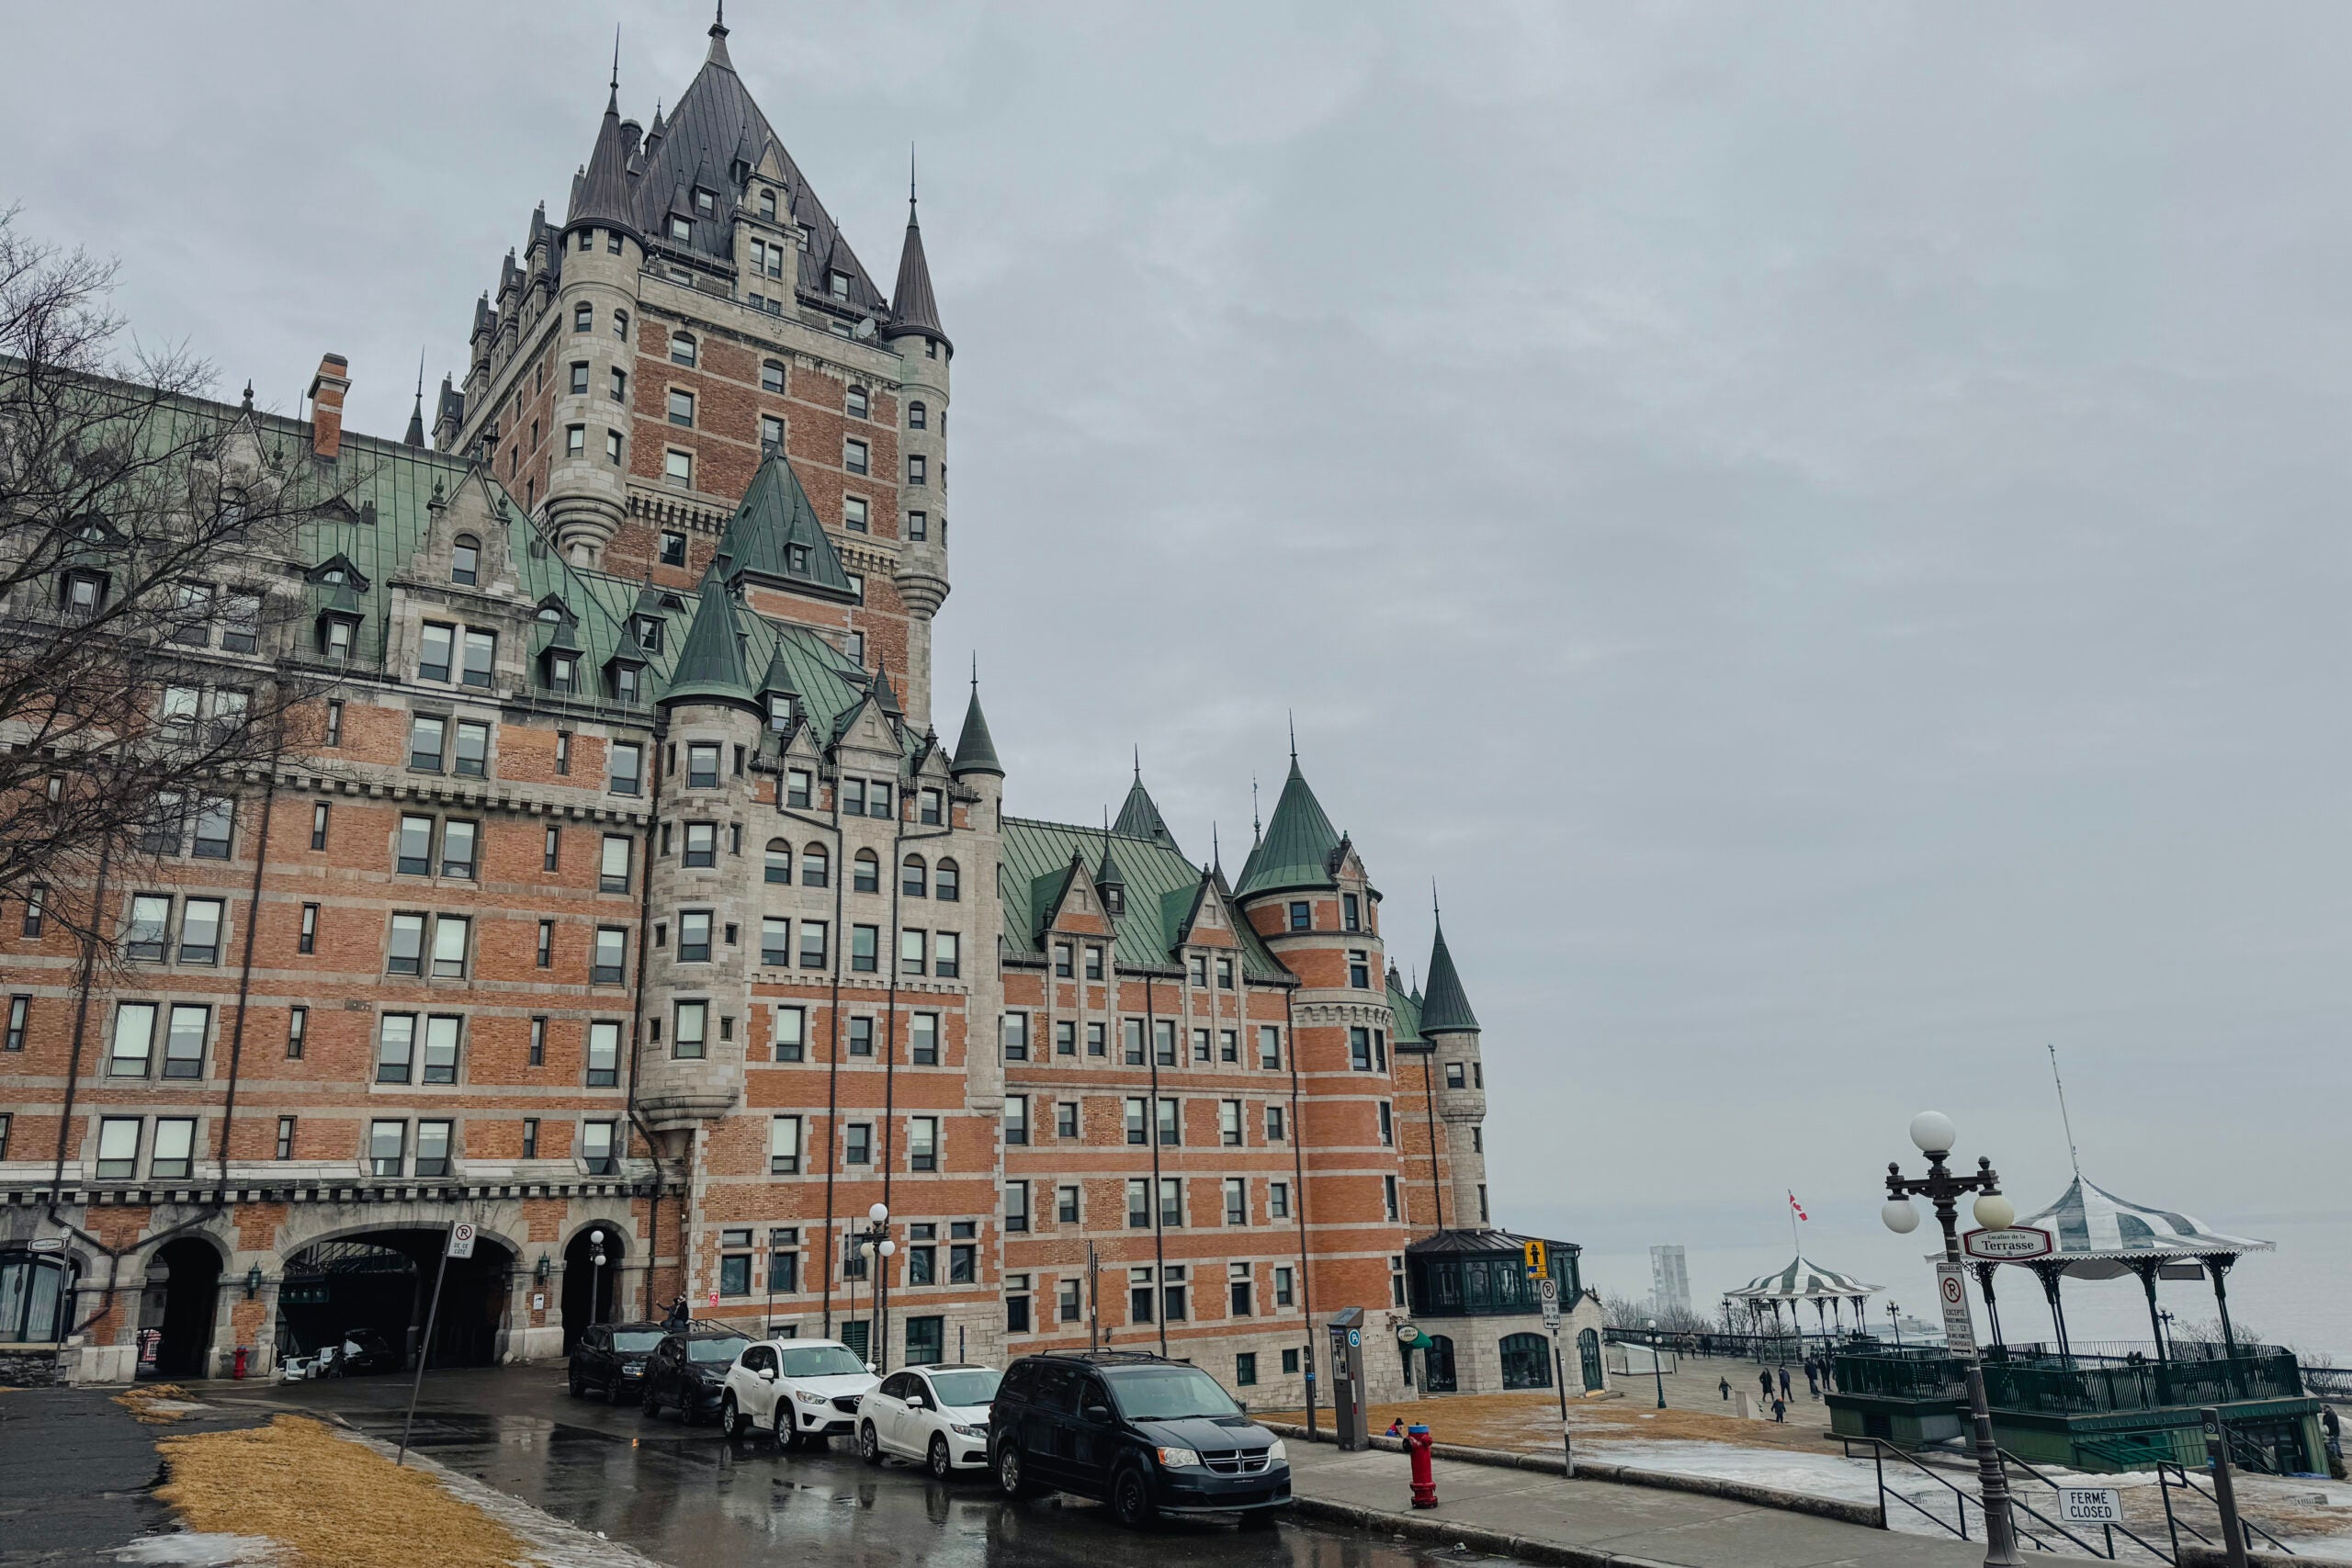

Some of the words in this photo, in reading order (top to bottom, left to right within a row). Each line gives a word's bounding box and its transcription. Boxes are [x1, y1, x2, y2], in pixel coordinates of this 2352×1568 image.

[1981, 1240, 2034, 1250] Terrasse
[2070, 1489, 2109, 1505] FERMÉ
[2070, 1506, 2112, 1518] CLOSED
